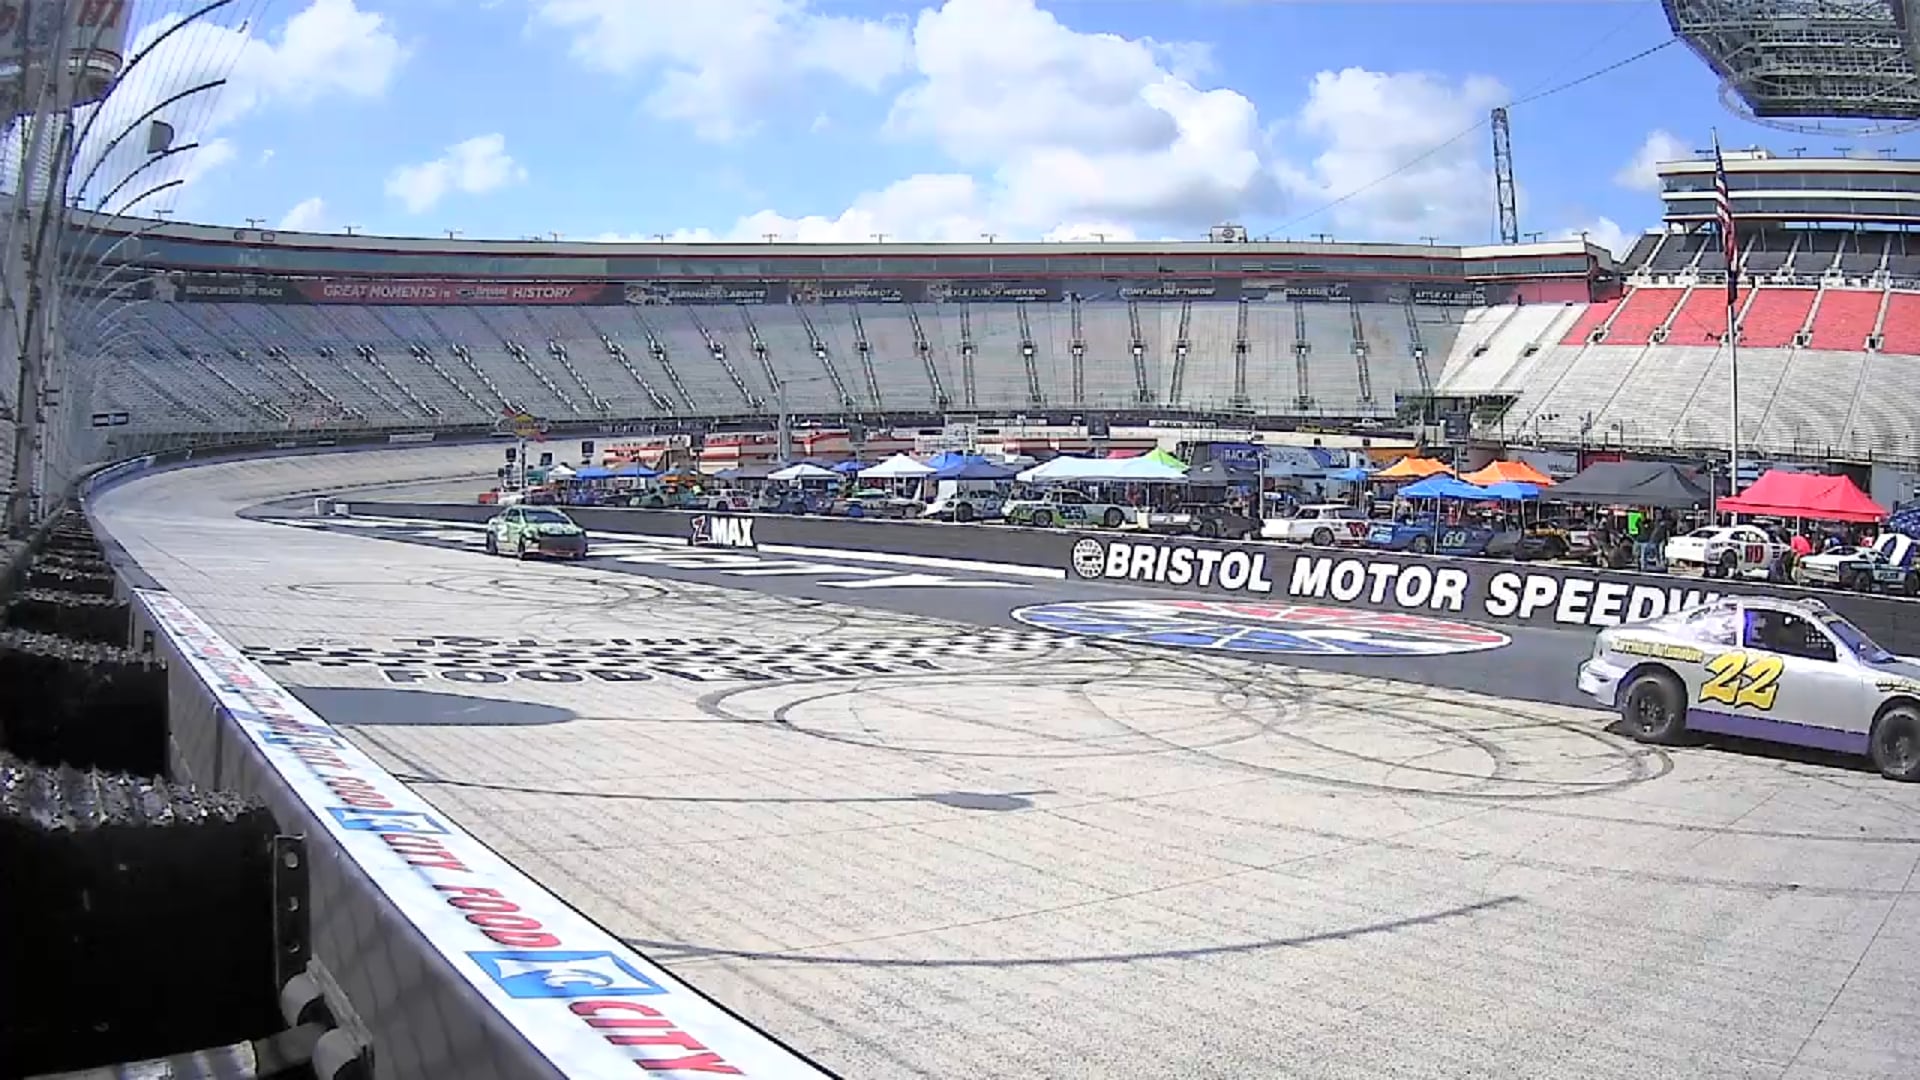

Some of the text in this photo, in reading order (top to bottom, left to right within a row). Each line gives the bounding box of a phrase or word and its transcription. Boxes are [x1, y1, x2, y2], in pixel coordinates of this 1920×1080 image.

[323, 285, 366, 298] GREAT
[368, 285, 437, 298] MOMENTS
[512, 287, 574, 298] HISTORY
[1104, 542, 1272, 592] BRISTOL
[1290, 556, 1468, 611] MOTOR
[1485, 572, 1720, 625] SPEEDW
[382, 668, 654, 684] FOOD
[1699, 651, 1784, 710] 22
[379, 833, 474, 874] CITY
[431, 884, 562, 948] FOOD
[569, 1000, 746, 1076] CITY
